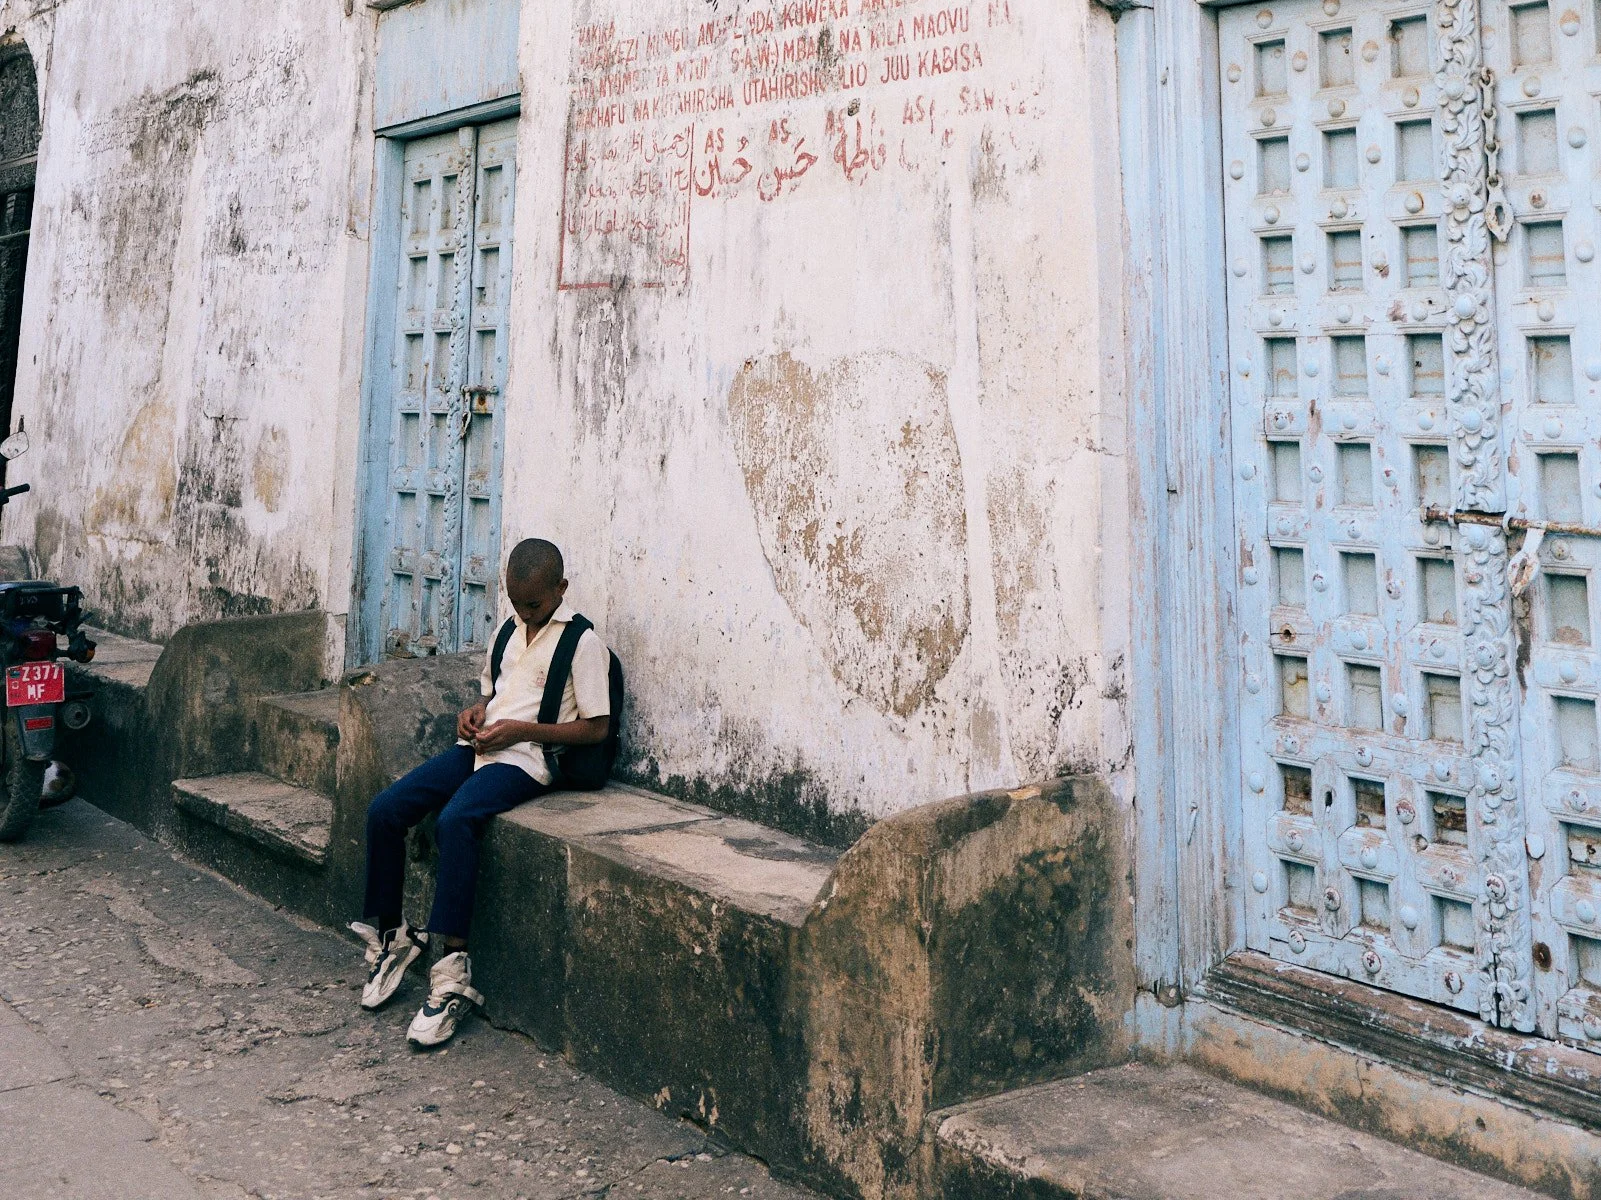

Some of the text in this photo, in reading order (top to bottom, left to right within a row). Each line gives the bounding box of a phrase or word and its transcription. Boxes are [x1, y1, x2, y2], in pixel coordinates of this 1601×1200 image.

[839, 27, 861, 53] NA
[913, 5, 969, 41] MAOVU
[880, 53, 910, 84] JUU
[918, 42, 983, 77] KABISA
